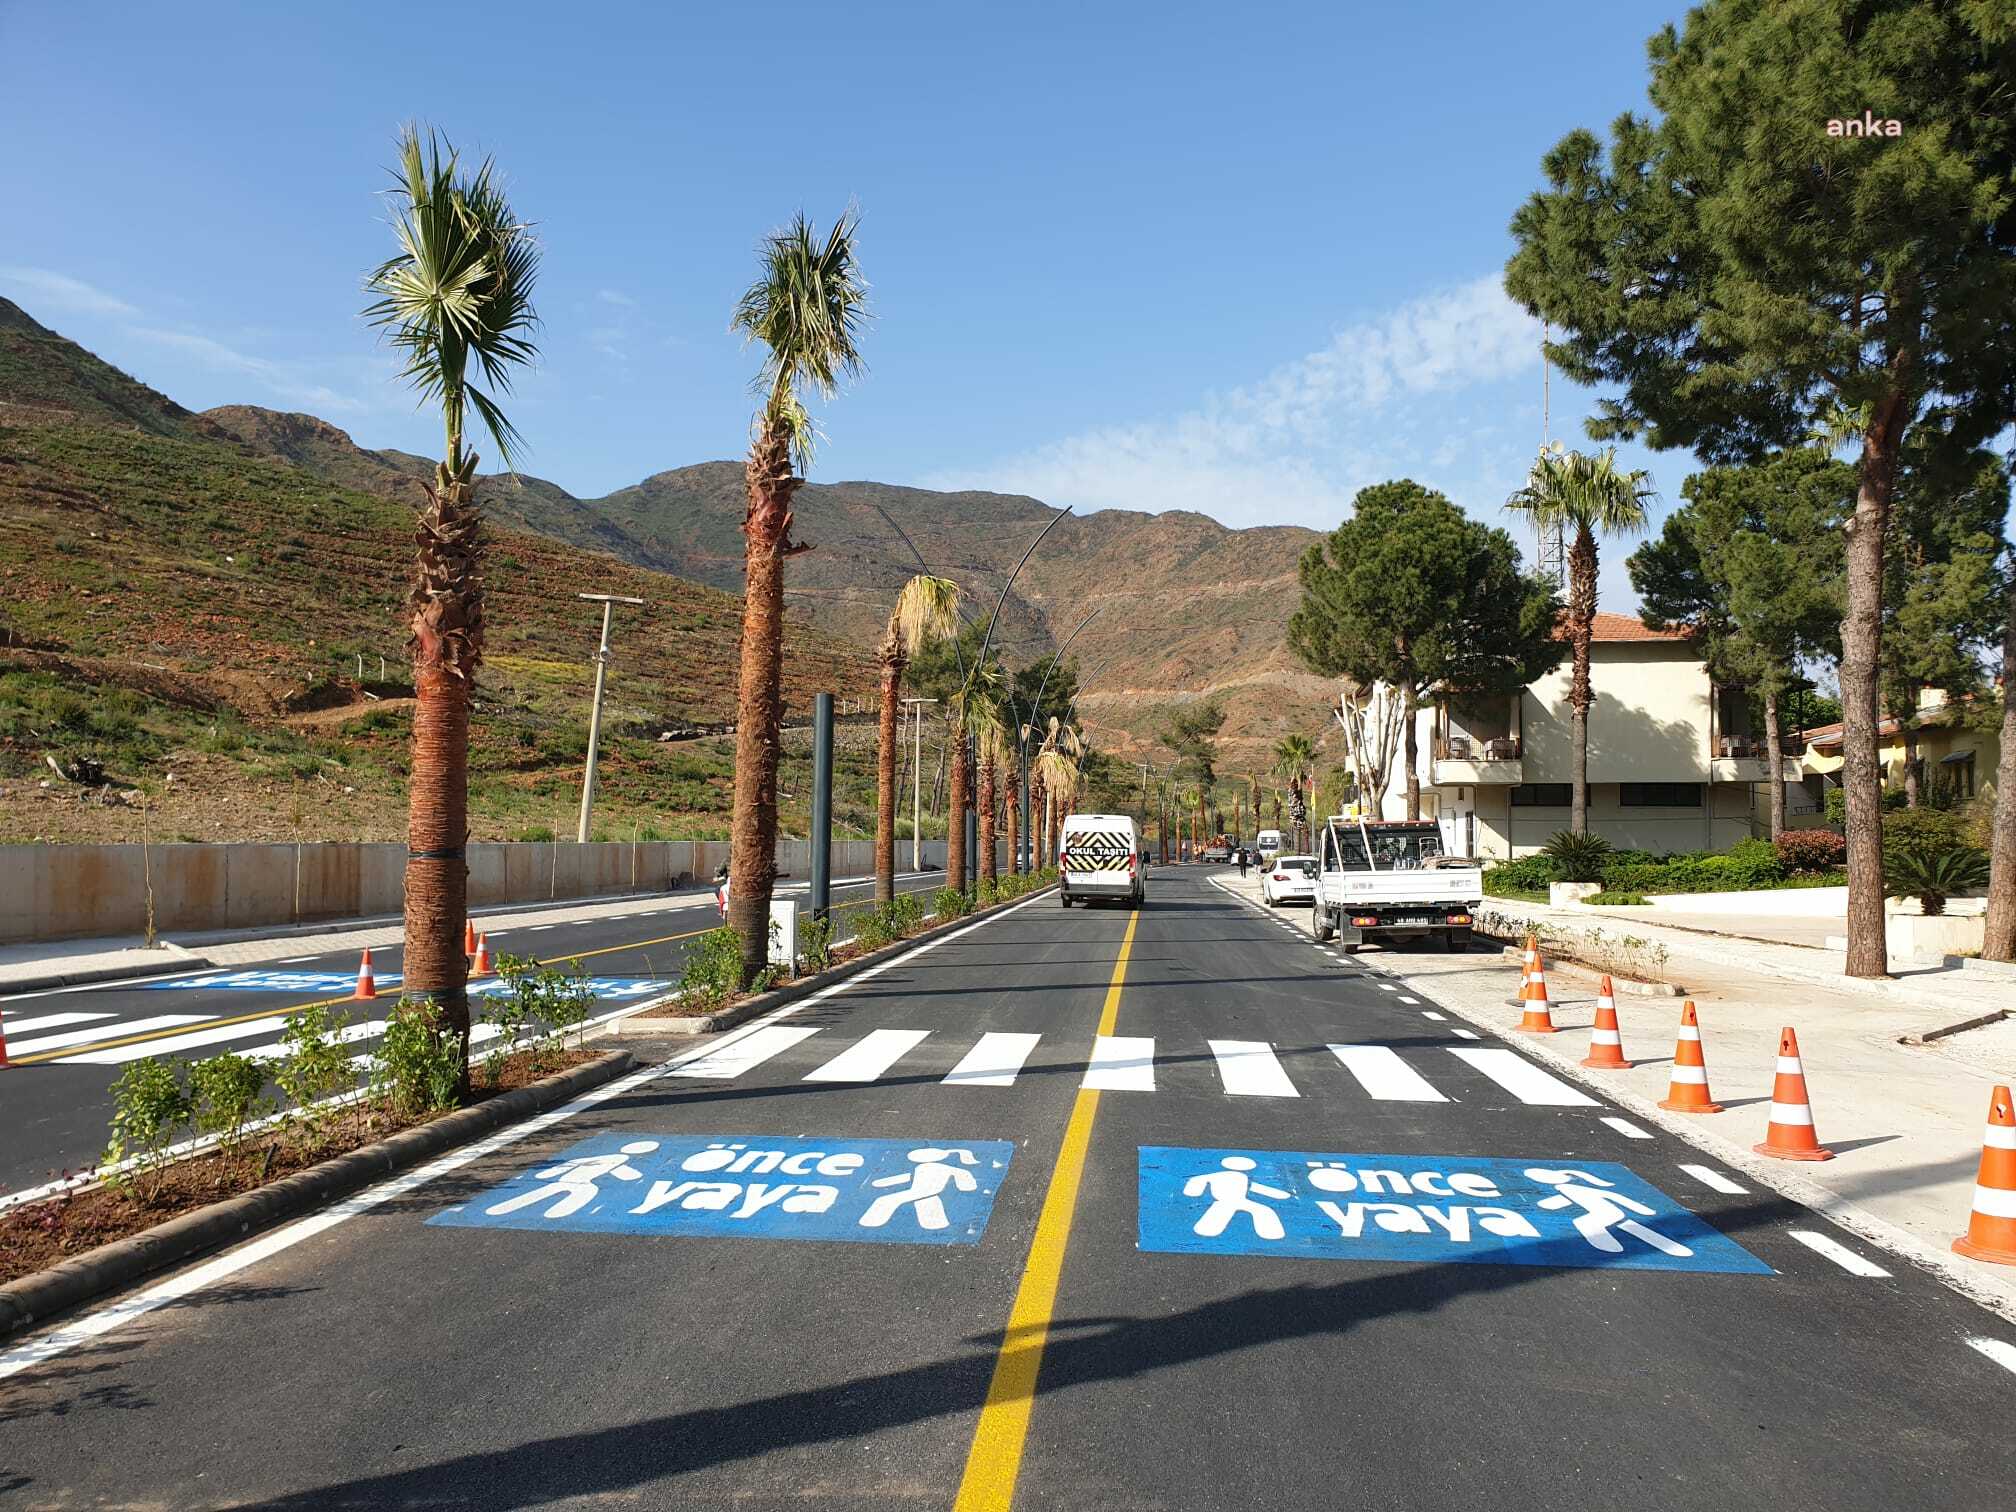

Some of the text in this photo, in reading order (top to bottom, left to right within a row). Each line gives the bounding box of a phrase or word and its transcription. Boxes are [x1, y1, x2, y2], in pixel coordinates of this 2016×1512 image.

[1069, 847, 1128, 856] OKUL TAŞITI
[629, 1179, 840, 1218] yaya
[1315, 1201, 1542, 1242] yaya
